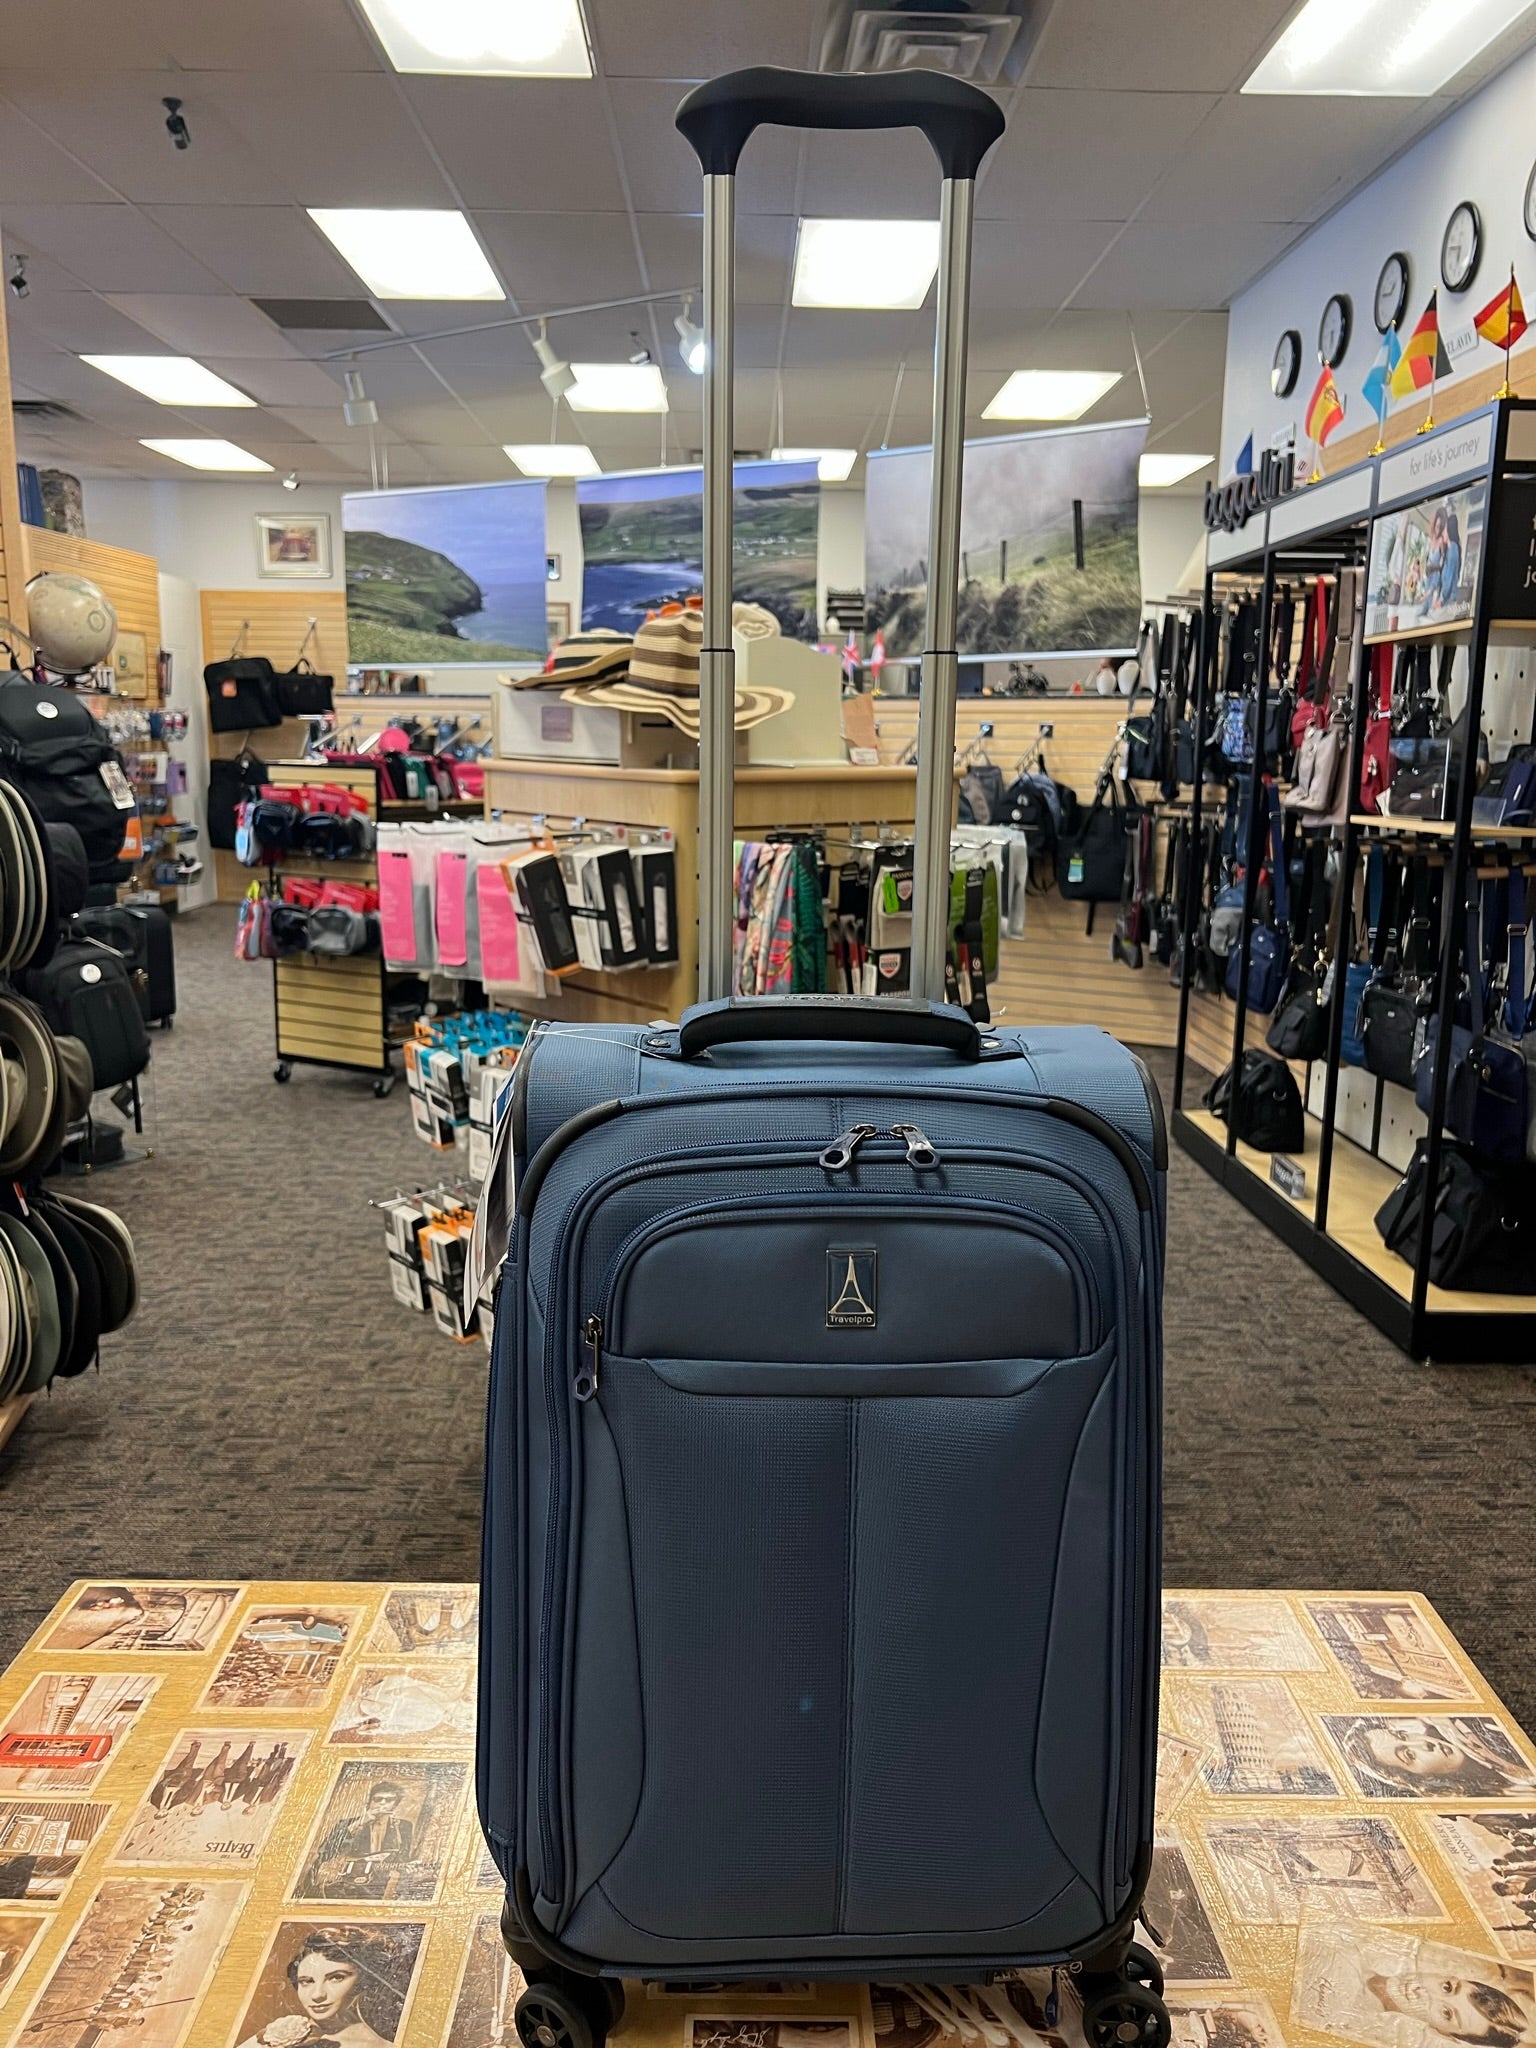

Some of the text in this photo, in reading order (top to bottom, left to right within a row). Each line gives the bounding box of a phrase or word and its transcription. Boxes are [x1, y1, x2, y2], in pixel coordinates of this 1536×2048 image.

[1409, 437, 1480, 476] for life's journey
[1204, 440, 1295, 533] baggallini
[830, 1315, 873, 1325] Travelpro
[203, 1839, 256, 1860] BEATLES
[1435, 1824, 1460, 1855] ROBERT
